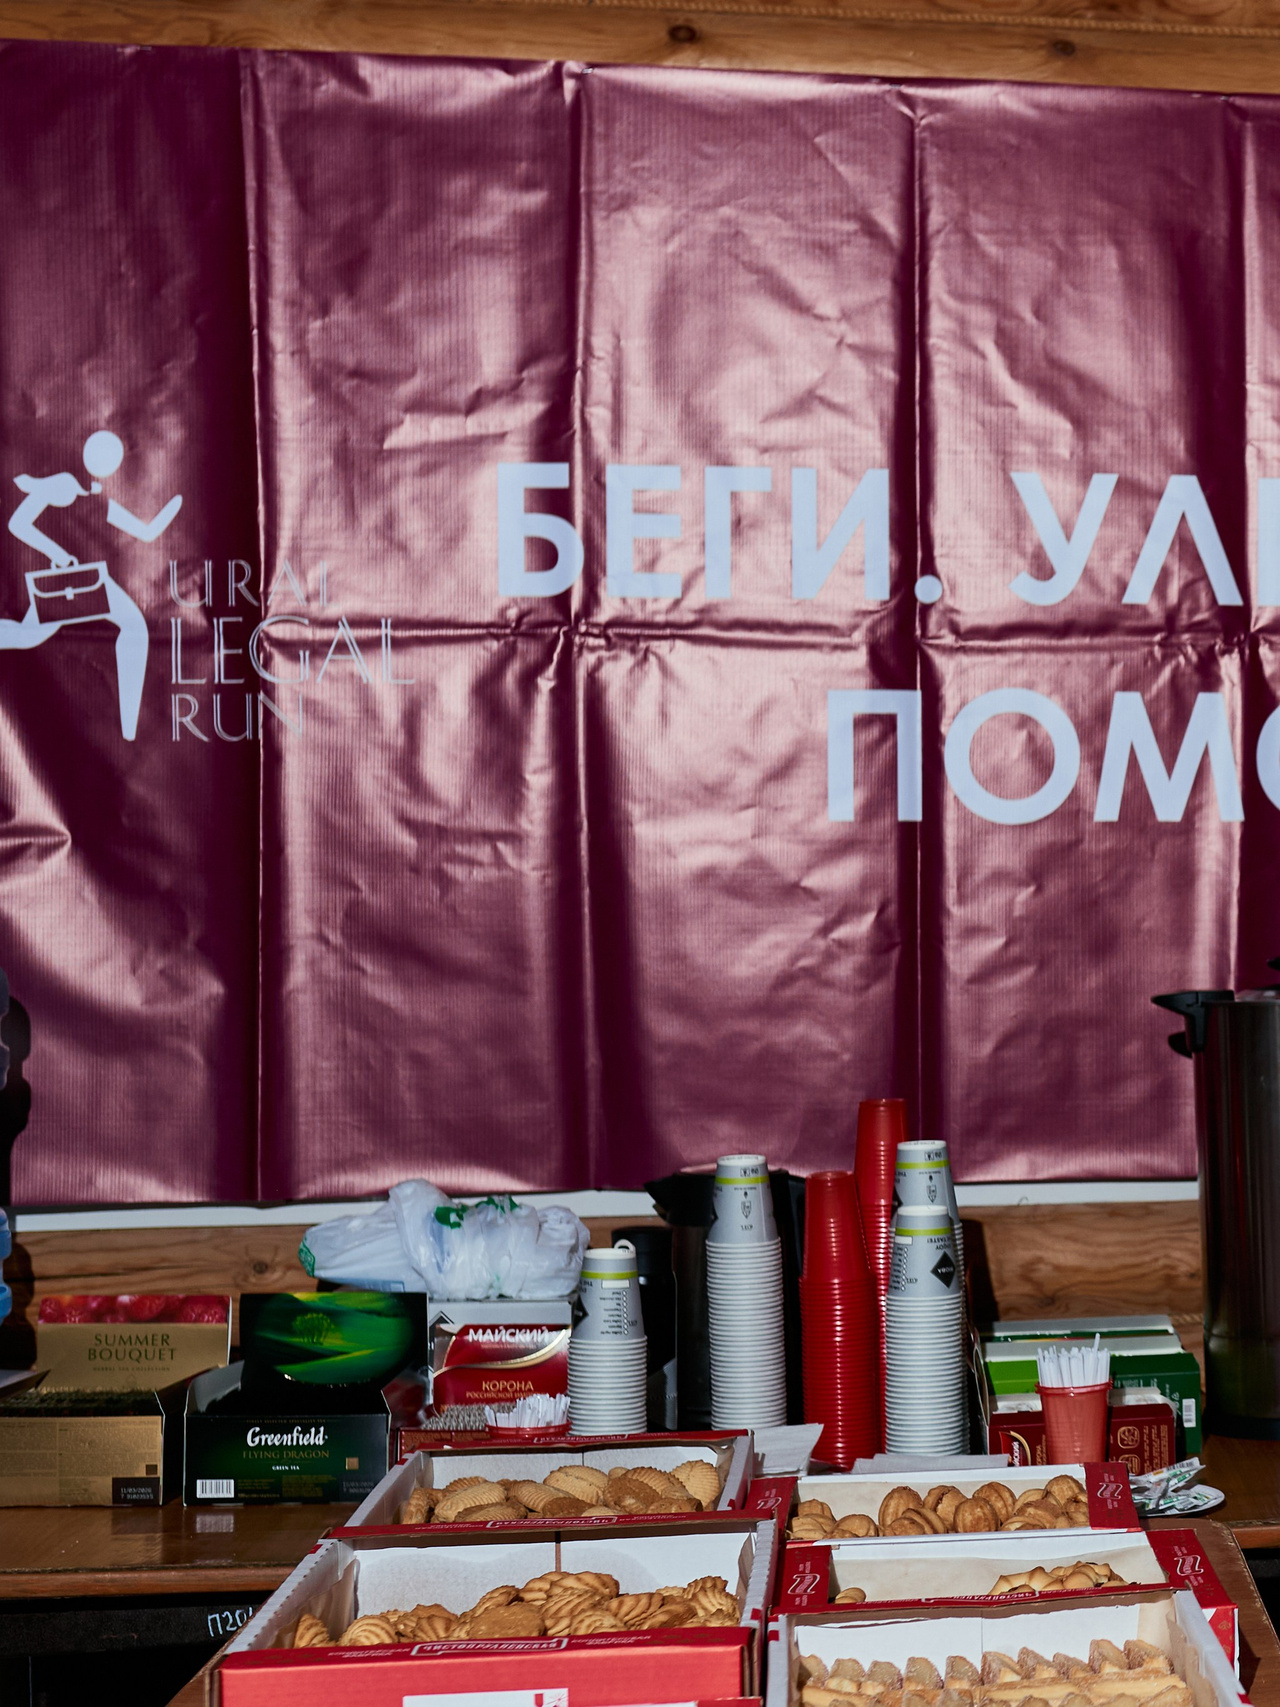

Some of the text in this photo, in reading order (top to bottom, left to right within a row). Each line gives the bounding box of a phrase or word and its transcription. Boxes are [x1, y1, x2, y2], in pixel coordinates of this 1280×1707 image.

[498, 462, 944, 604] БЕГИ.
[170, 615, 415, 684] LEGAL
[171, 691, 303, 742] RUN
[94, 1333, 171, 1347] SUMMER
[468, 1325, 549, 1343] МАЙСКИЙ
[88, 1348, 177, 1363] BOUQUET
[482, 1380, 534, 1392] КОРОНА
[246, 1425, 326, 1447] Greenfield
[243, 1450, 330, 1459] FLYING DRAGON
